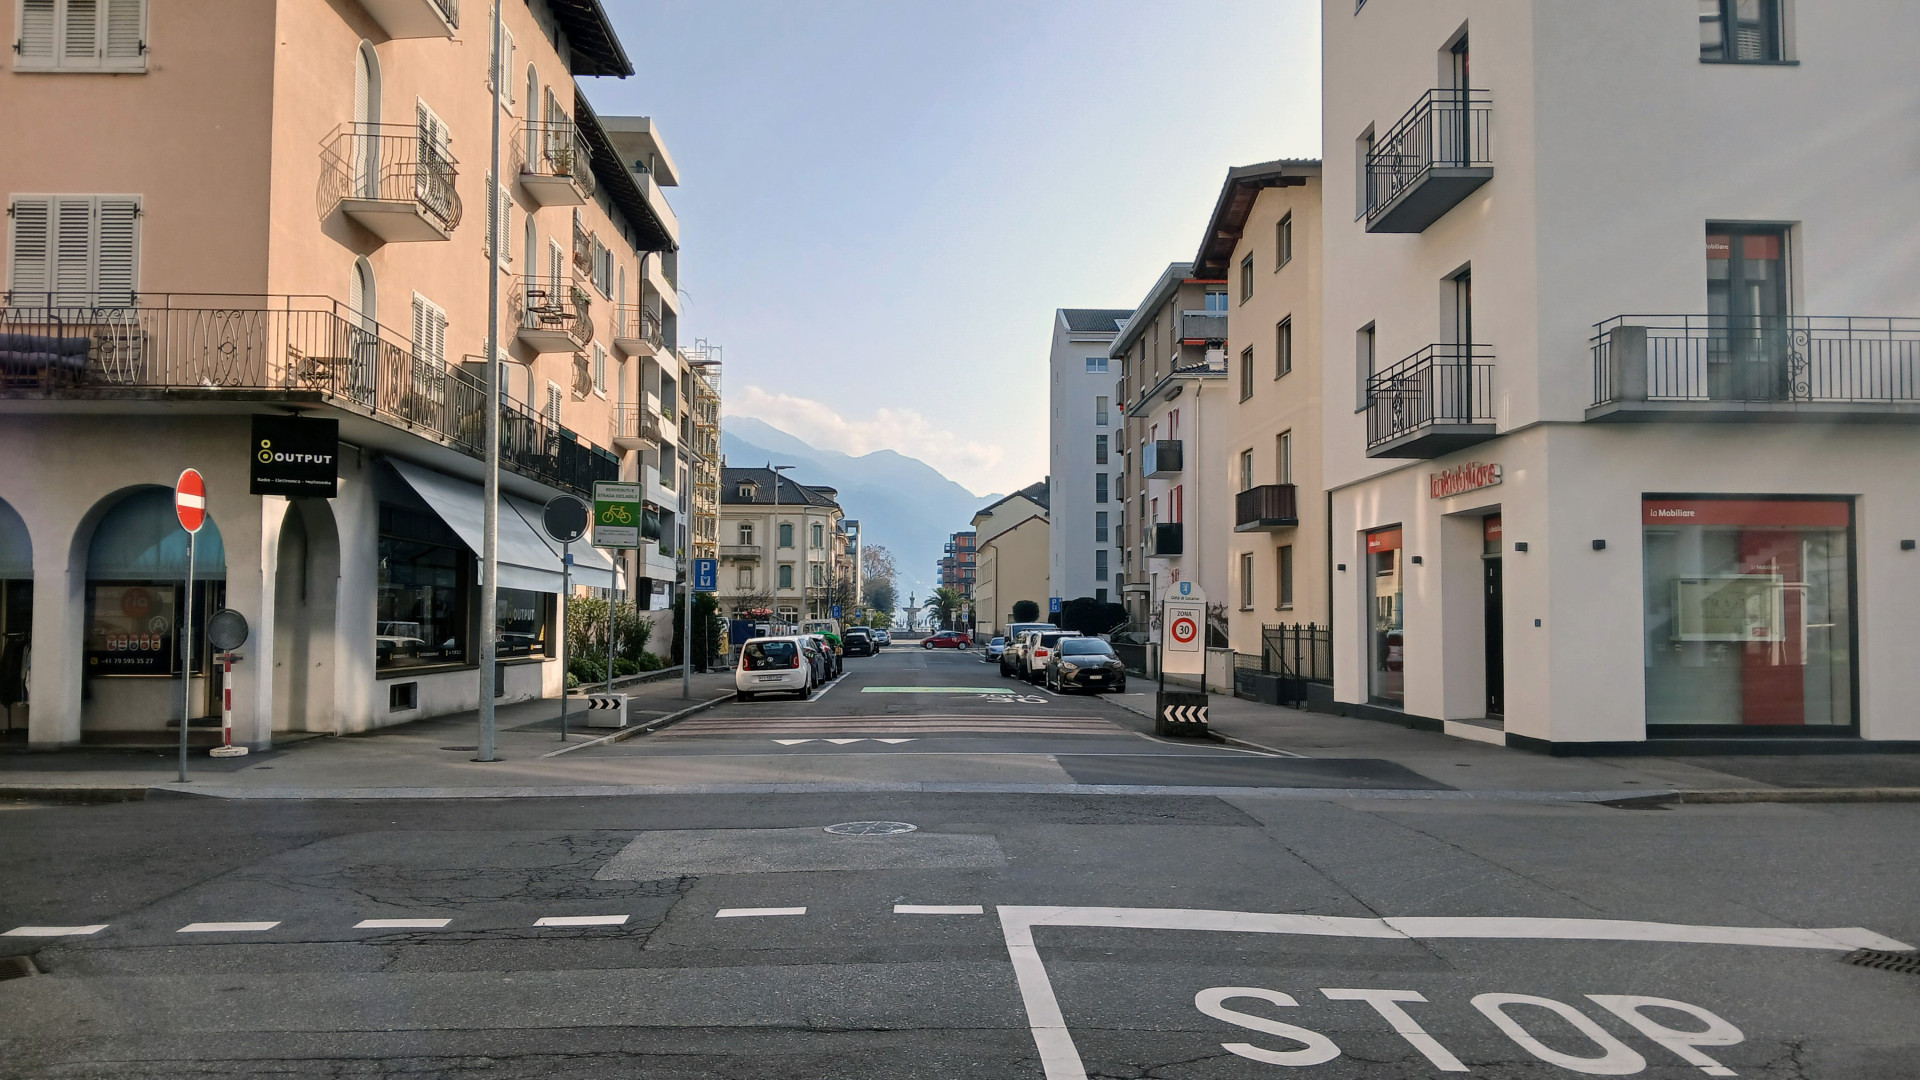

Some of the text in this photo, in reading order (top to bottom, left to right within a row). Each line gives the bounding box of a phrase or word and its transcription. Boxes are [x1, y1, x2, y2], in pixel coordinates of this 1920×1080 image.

[274, 452, 333, 464] OUTPUT
[1430, 462, 1496, 499] la Mobiliare
[1650, 508, 1695, 517] la Mobiliare
[701, 561, 710, 576] P
[513, 608, 535, 621] OUTPUT
[1179, 625, 1190, 635] 30
[1194, 986, 1746, 1077] STOP
